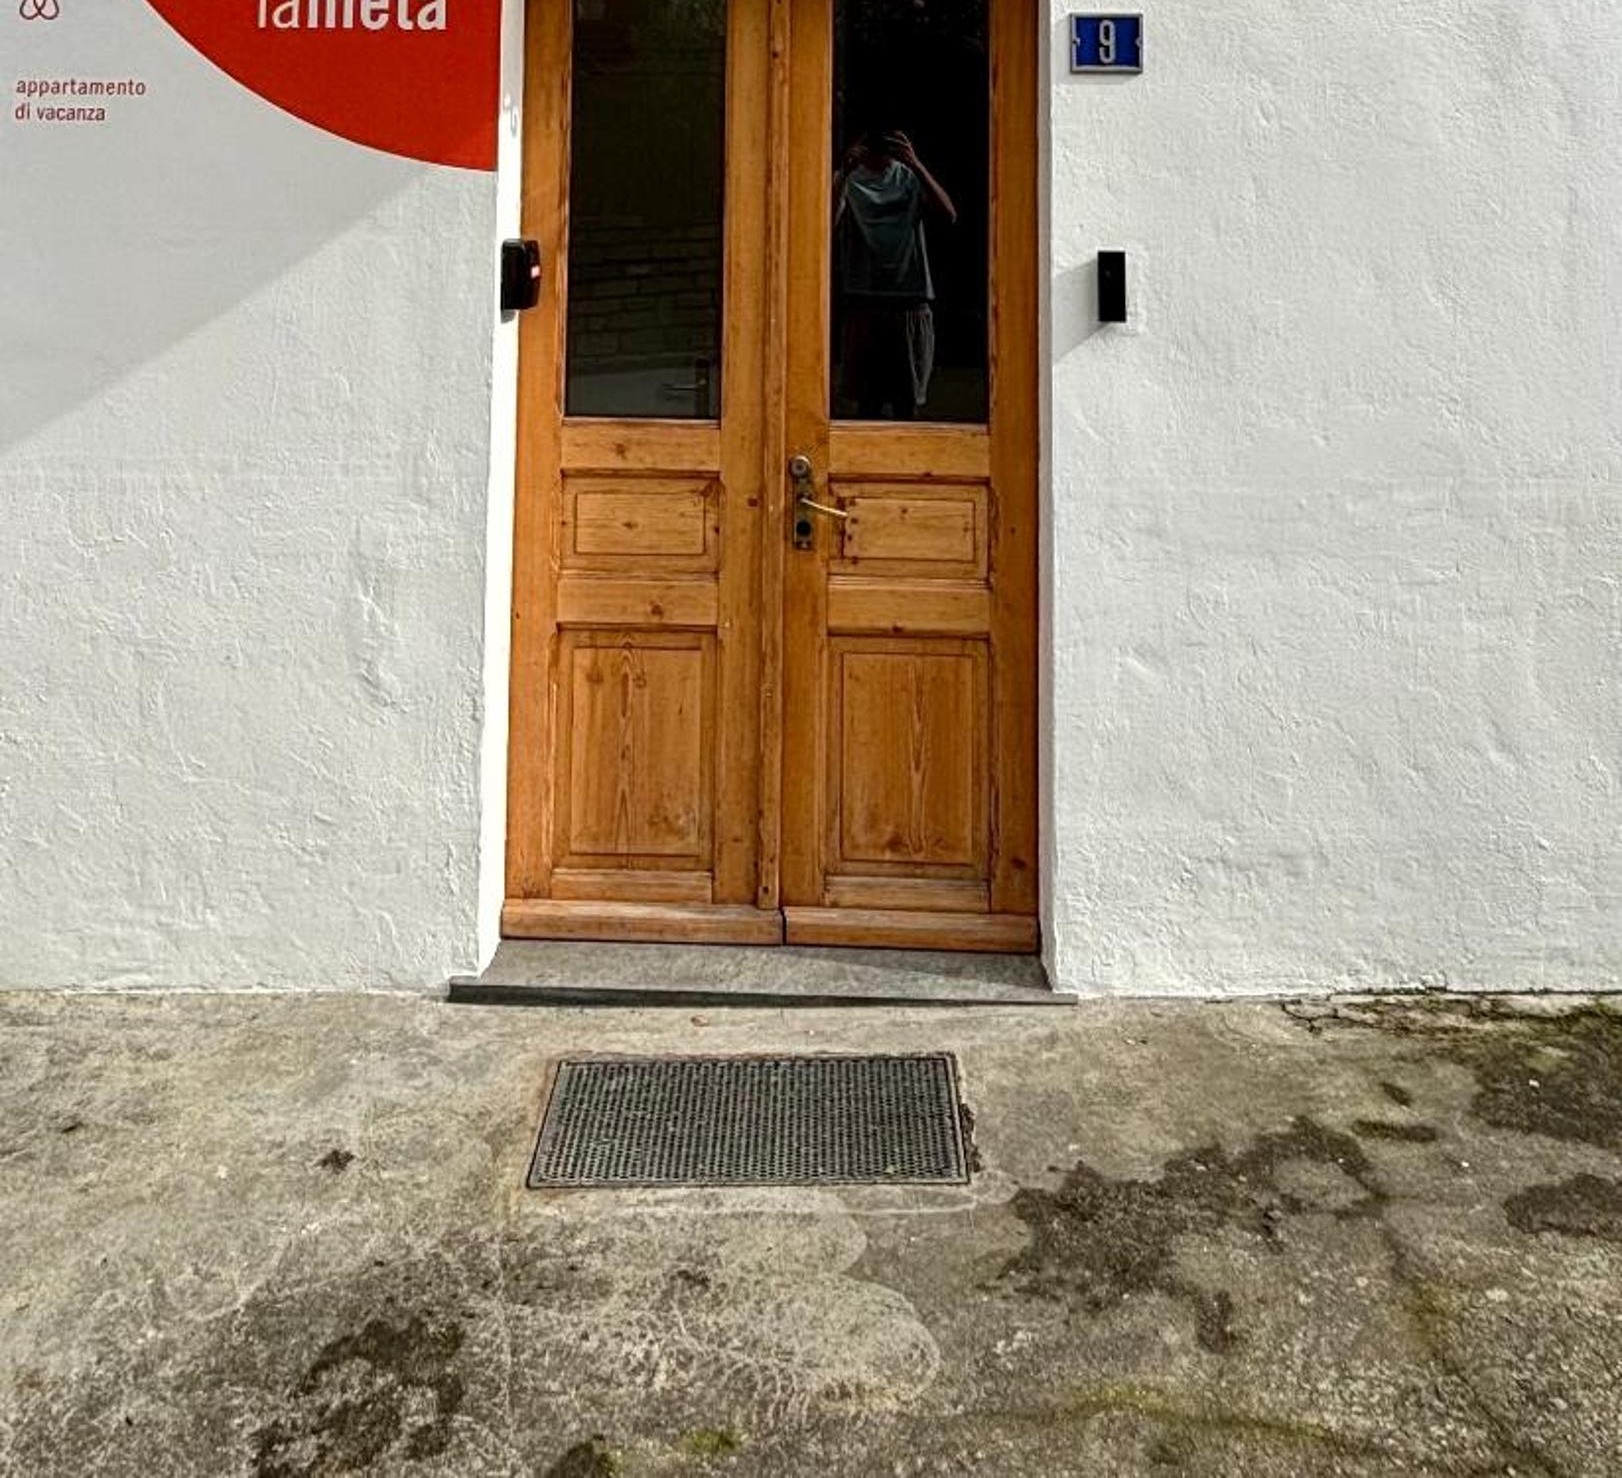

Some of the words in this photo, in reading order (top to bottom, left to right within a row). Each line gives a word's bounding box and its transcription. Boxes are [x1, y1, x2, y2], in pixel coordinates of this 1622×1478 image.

[1099, 19, 1116, 64] 9
[16, 78, 146, 97] appartamento
[15, 103, 30, 120] di
[37, 107, 105, 121] vacanza
